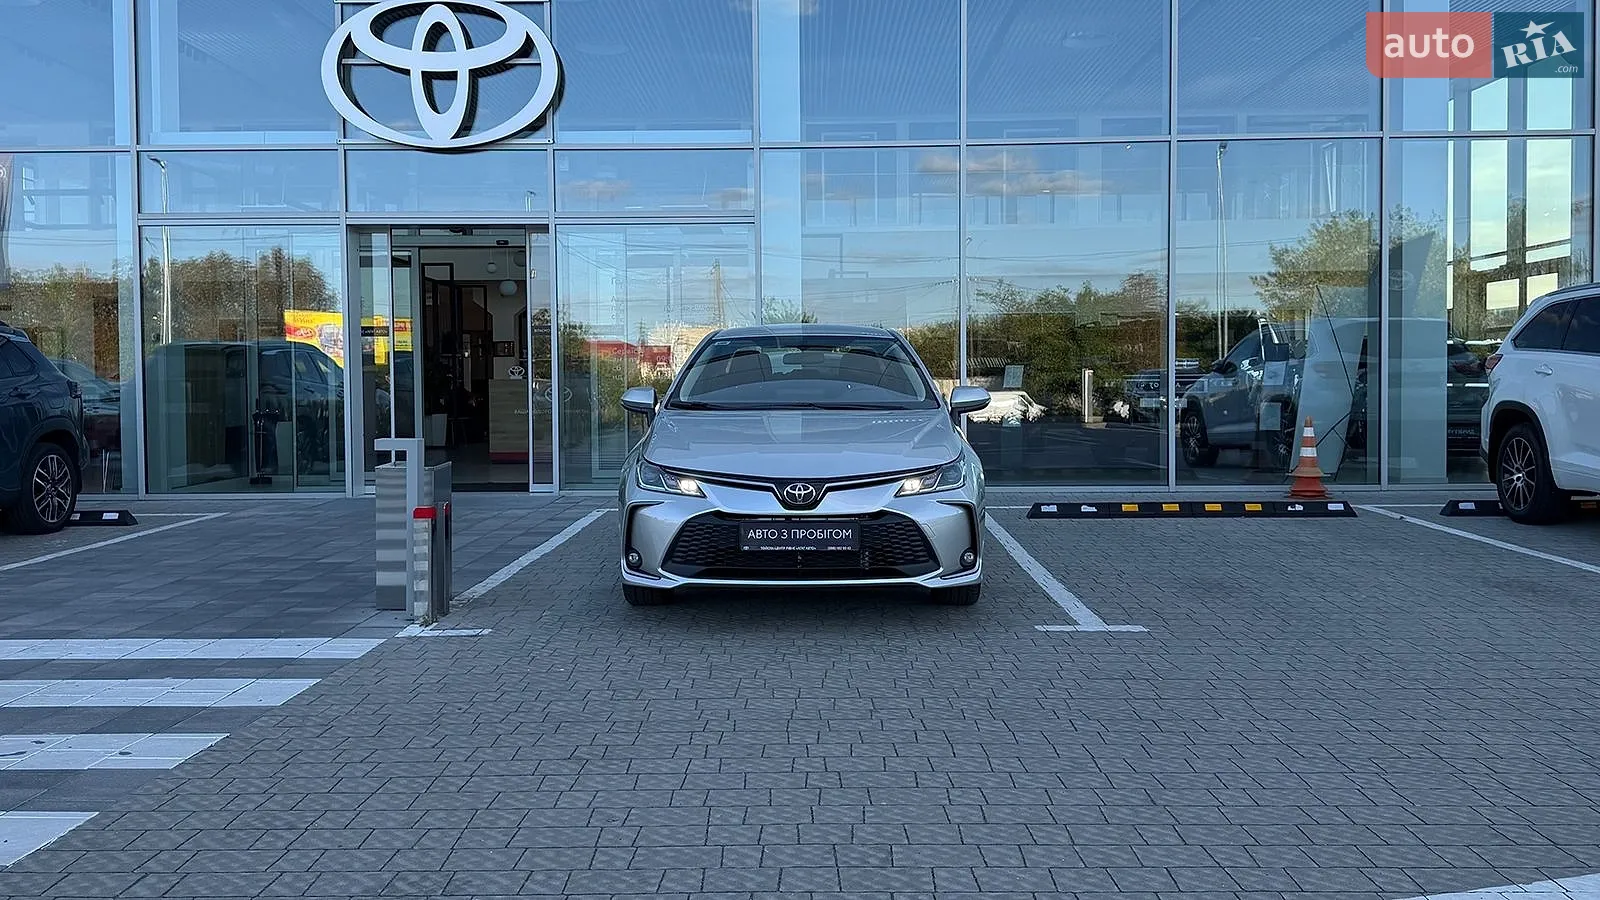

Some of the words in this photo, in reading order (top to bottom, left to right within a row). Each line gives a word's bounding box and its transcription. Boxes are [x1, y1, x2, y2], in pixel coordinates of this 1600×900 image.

[747, 529, 778, 539] АВТО
[781, 529, 788, 539] З
[791, 529, 852, 539] ПРОБІГОМ
